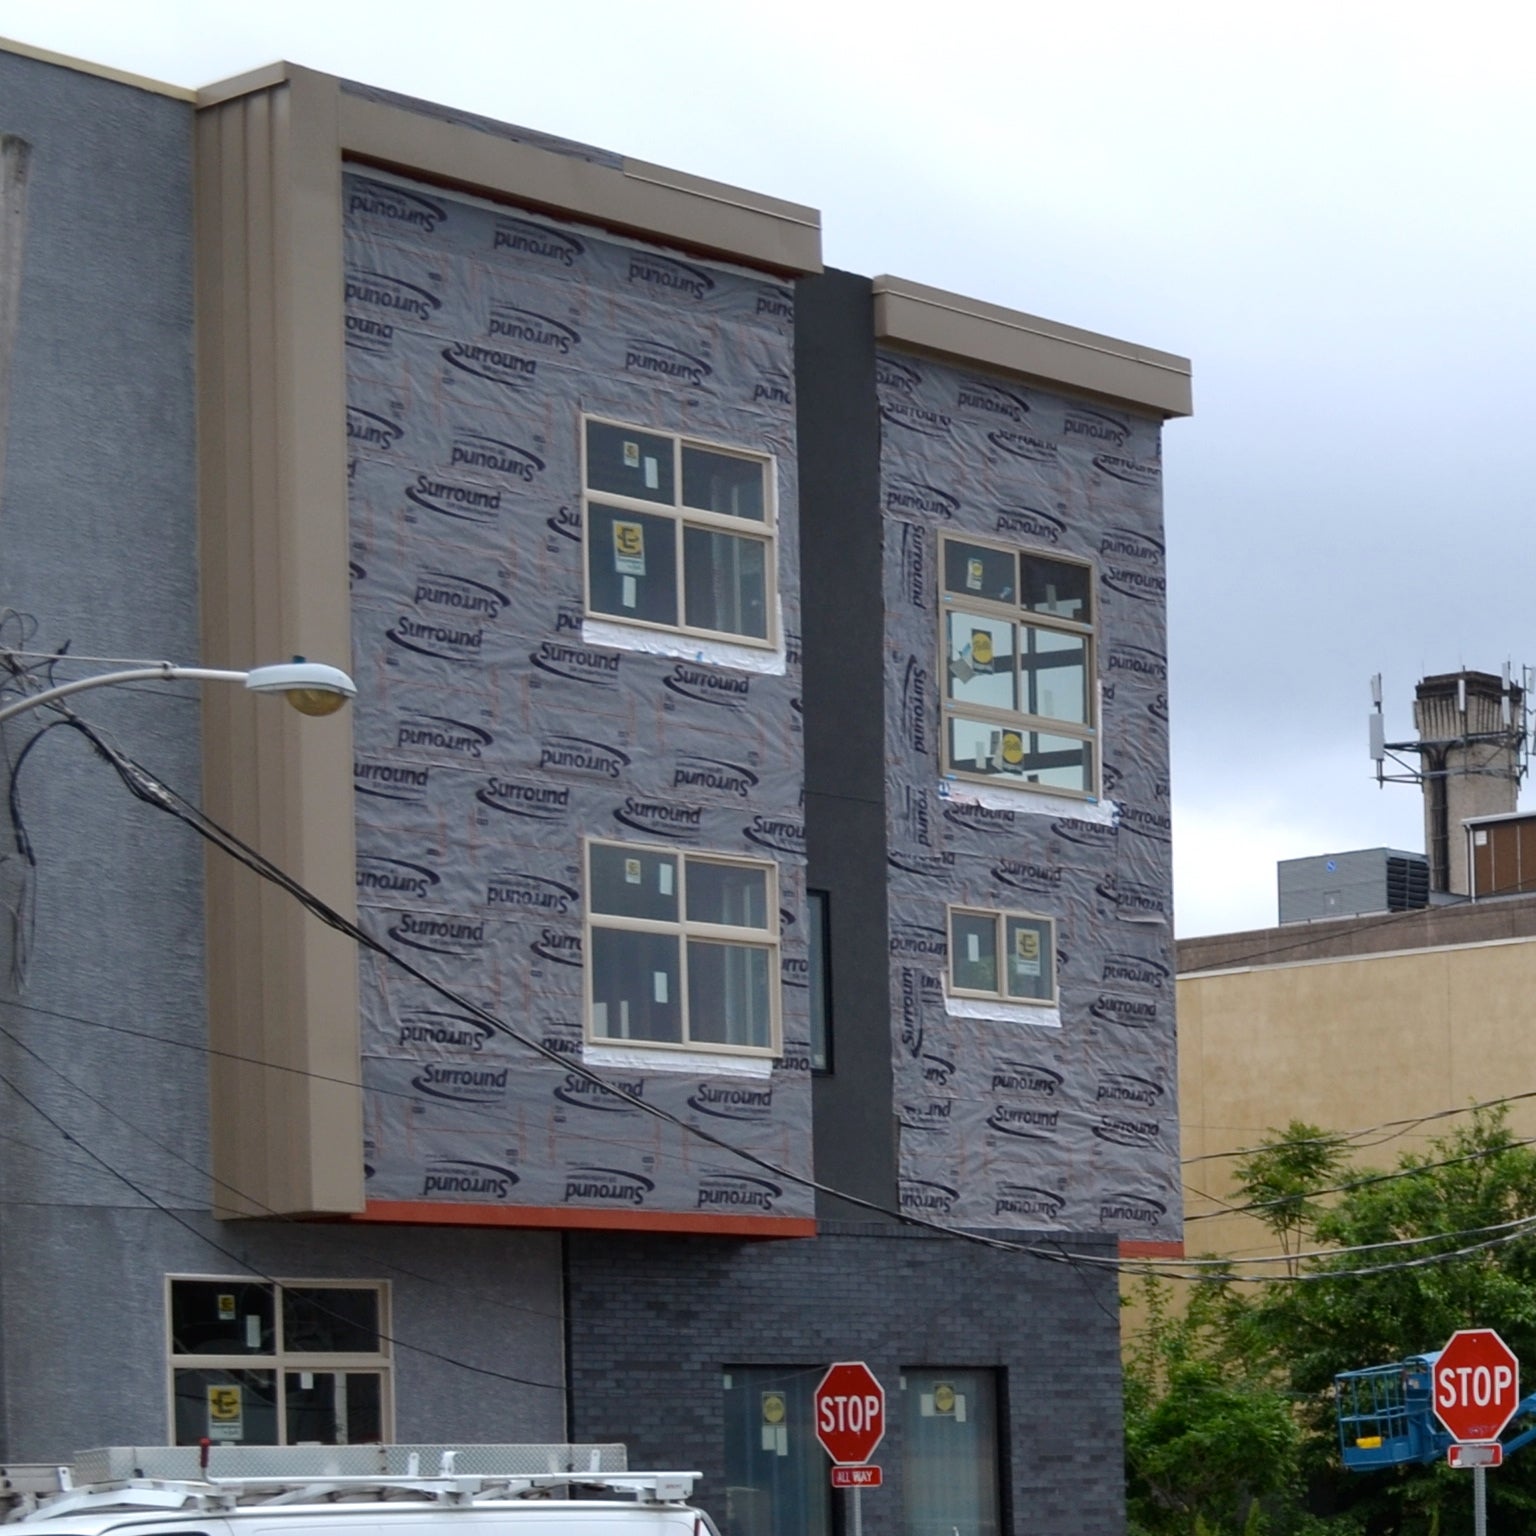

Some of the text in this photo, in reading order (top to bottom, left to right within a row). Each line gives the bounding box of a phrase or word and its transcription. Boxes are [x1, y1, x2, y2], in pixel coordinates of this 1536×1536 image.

[351, 195, 435, 233] Surround
[495, 230, 574, 267] Surround
[629, 262, 706, 300] Surround
[489, 318, 571, 354] Surround
[626, 351, 701, 388] Surround
[1063, 416, 1124, 447] Surround
[451, 447, 534, 482] Surround
[416, 475, 501, 510] Surround
[887, 491, 952, 520] Surround
[1101, 537, 1160, 565] Surround
[912, 524, 927, 611] Surround
[414, 585, 499, 619] Surround
[398, 616, 483, 648] Surround
[540, 641, 620, 672] Surround
[1108, 656, 1167, 681] Surround
[673, 664, 749, 695] Surround
[913, 667, 928, 756] Surround
[397, 727, 482, 759] Surround
[353, 762, 428, 786] urround
[540, 748, 621, 778] Surround
[487, 777, 570, 806] Surround
[673, 767, 749, 797] Surround
[624, 797, 701, 824] Surround
[753, 815, 805, 839] Surrou
[356, 871, 428, 898] Surroun
[1001, 859, 1062, 882] Surround
[487, 887, 568, 915] Surround
[400, 914, 484, 941] Surround
[1102, 965, 1163, 988] Surround
[400, 1024, 484, 1052] Surround
[423, 1063, 507, 1089] Surround
[992, 1075, 1056, 1096] Surround
[697, 1084, 772, 1107] Surround
[1096, 1086, 1156, 1107] Surround
[995, 1105, 1060, 1126] Surround
[423, 1176, 508, 1199] Surround
[565, 1182, 644, 1205] Surround
[697, 1189, 772, 1210] Surround
[996, 1198, 1057, 1219] Surround
[1100, 1204, 1159, 1226] Surround
[1439, 1365, 1512, 1408] STOP
[820, 1395, 880, 1432] STOP
[837, 1470, 873, 1483] ALL WAY
